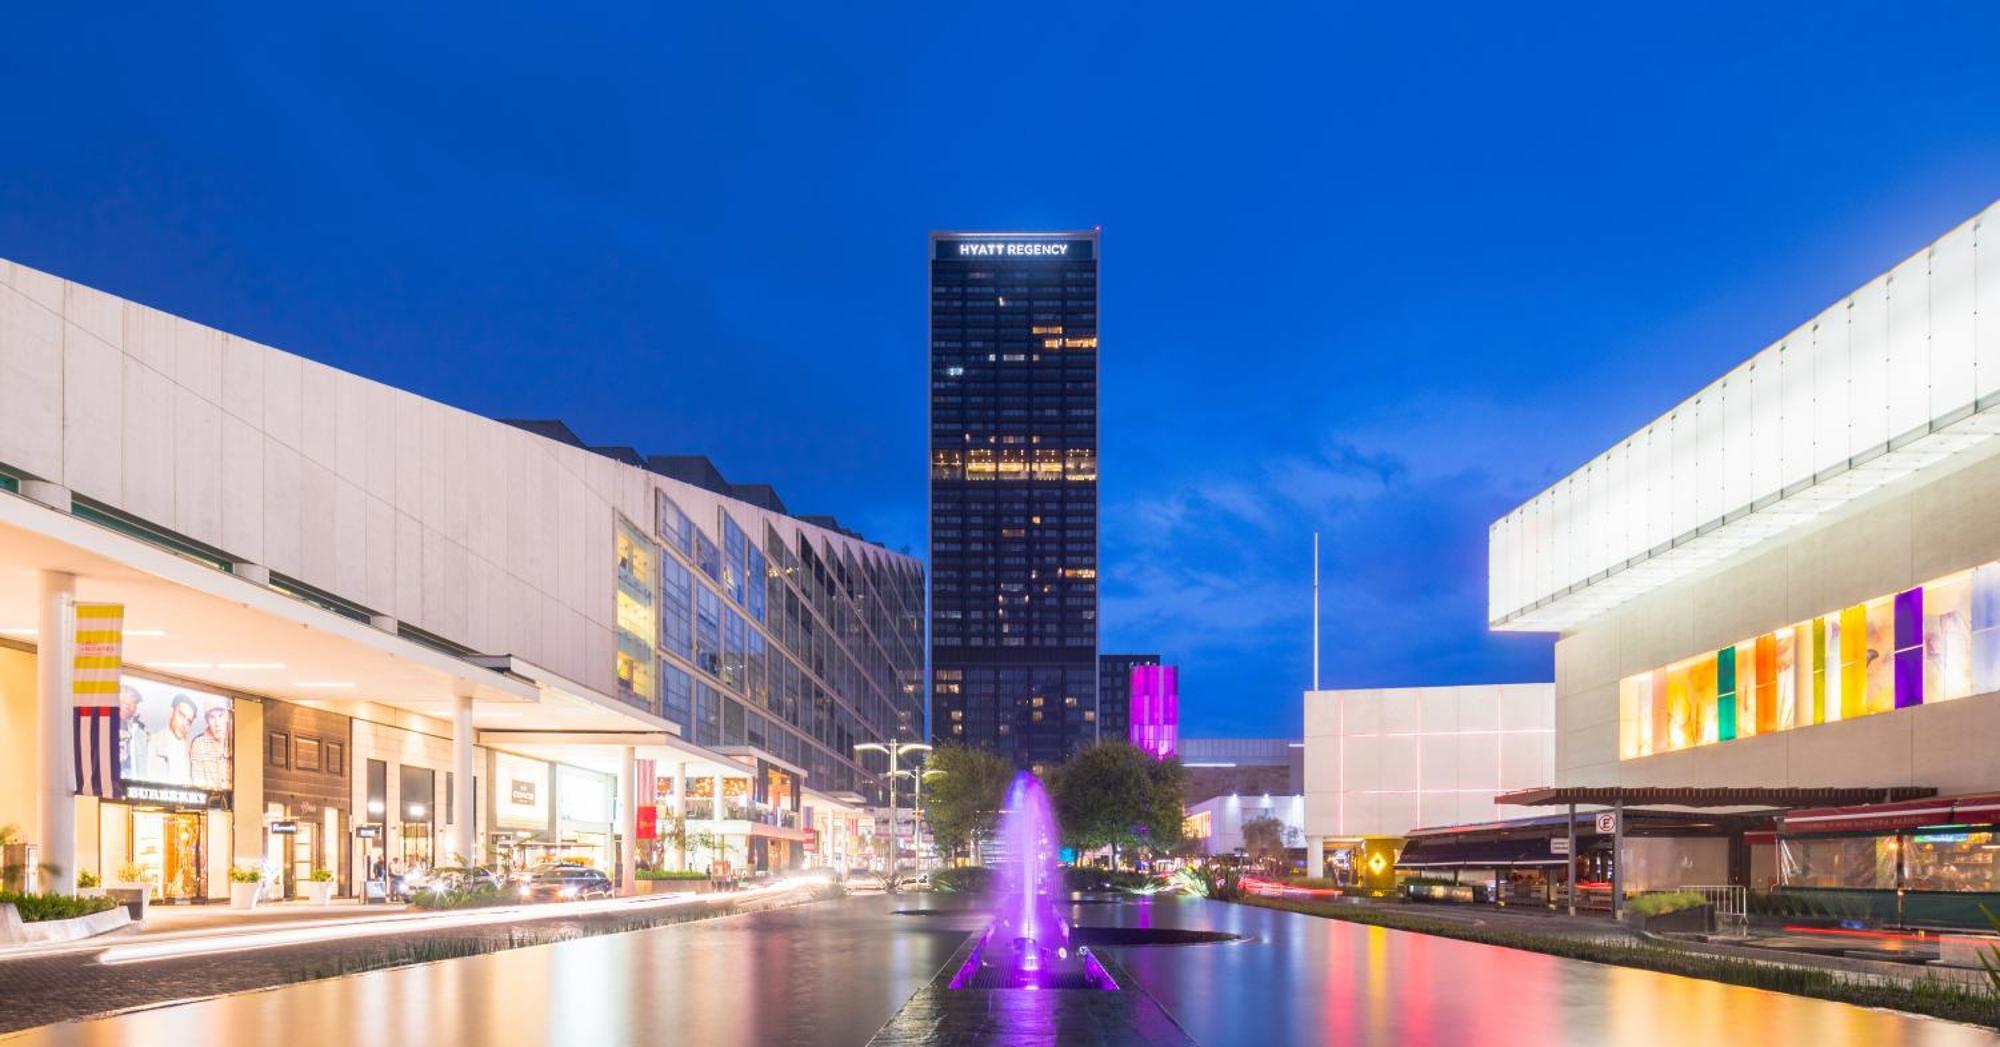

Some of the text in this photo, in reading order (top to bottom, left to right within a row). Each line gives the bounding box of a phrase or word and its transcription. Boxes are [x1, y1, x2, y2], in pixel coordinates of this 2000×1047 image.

[960, 244, 1068, 256] HYATT REGENCY
[1603, 818, 1610, 829] E
